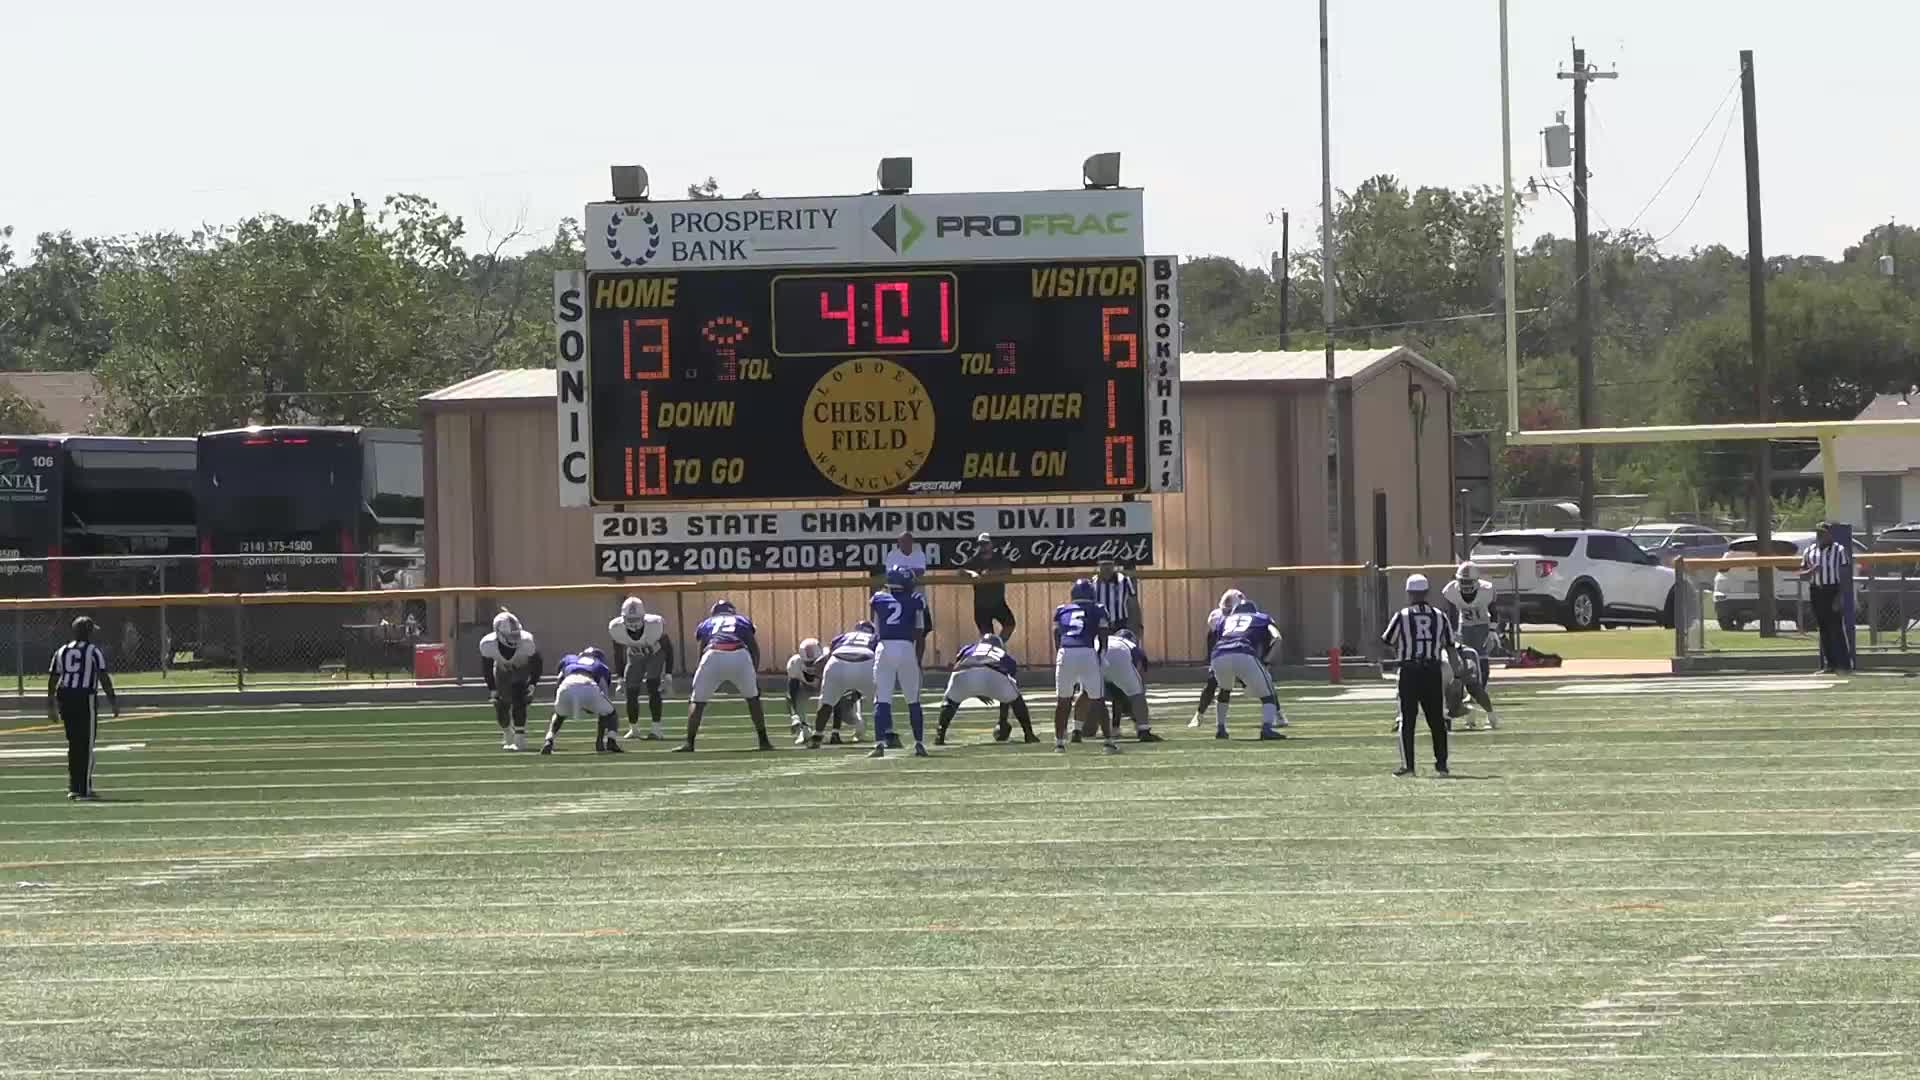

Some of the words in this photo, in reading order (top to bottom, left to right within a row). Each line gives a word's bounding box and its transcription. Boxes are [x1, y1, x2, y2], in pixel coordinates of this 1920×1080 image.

[671, 209, 838, 233] PROSPERITY
[936, 211, 1133, 238] PROFRAC
[672, 239, 748, 262] BANK
[594, 277, 680, 309] HOME
[1031, 266, 1138, 298] VISITOR
[623, 319, 670, 380] 13
[738, 358, 773, 380] TOL
[961, 353, 994, 375] TOL
[559, 289, 587, 484] SONIC
[657, 400, 736, 428] DOWN
[814, 400, 922, 423] CHESLEY
[972, 392, 1083, 421] QUARTER
[832, 429, 907, 450] FIELD
[32, 456, 54, 467] 106
[624, 446, 668, 496] 10
[673, 458, 702, 484] TO
[711, 457, 745, 484] GO
[962, 452, 1021, 479] BALL
[1031, 451, 1067, 478] ON
[1104, 436, 1135, 486] 0
[602, 516, 669, 538] 2013
[687, 514, 778, 536] STATE
[801, 510, 976, 534] CHAMPIONS
[1089, 507, 1127, 528] 2A
[1031, 538, 1149, 565] Finalist
[886, 602, 902, 625] 2
[1067, 611, 1085, 635] 5
[1414, 615, 1432, 639] R
[65, 649, 81, 673] C
